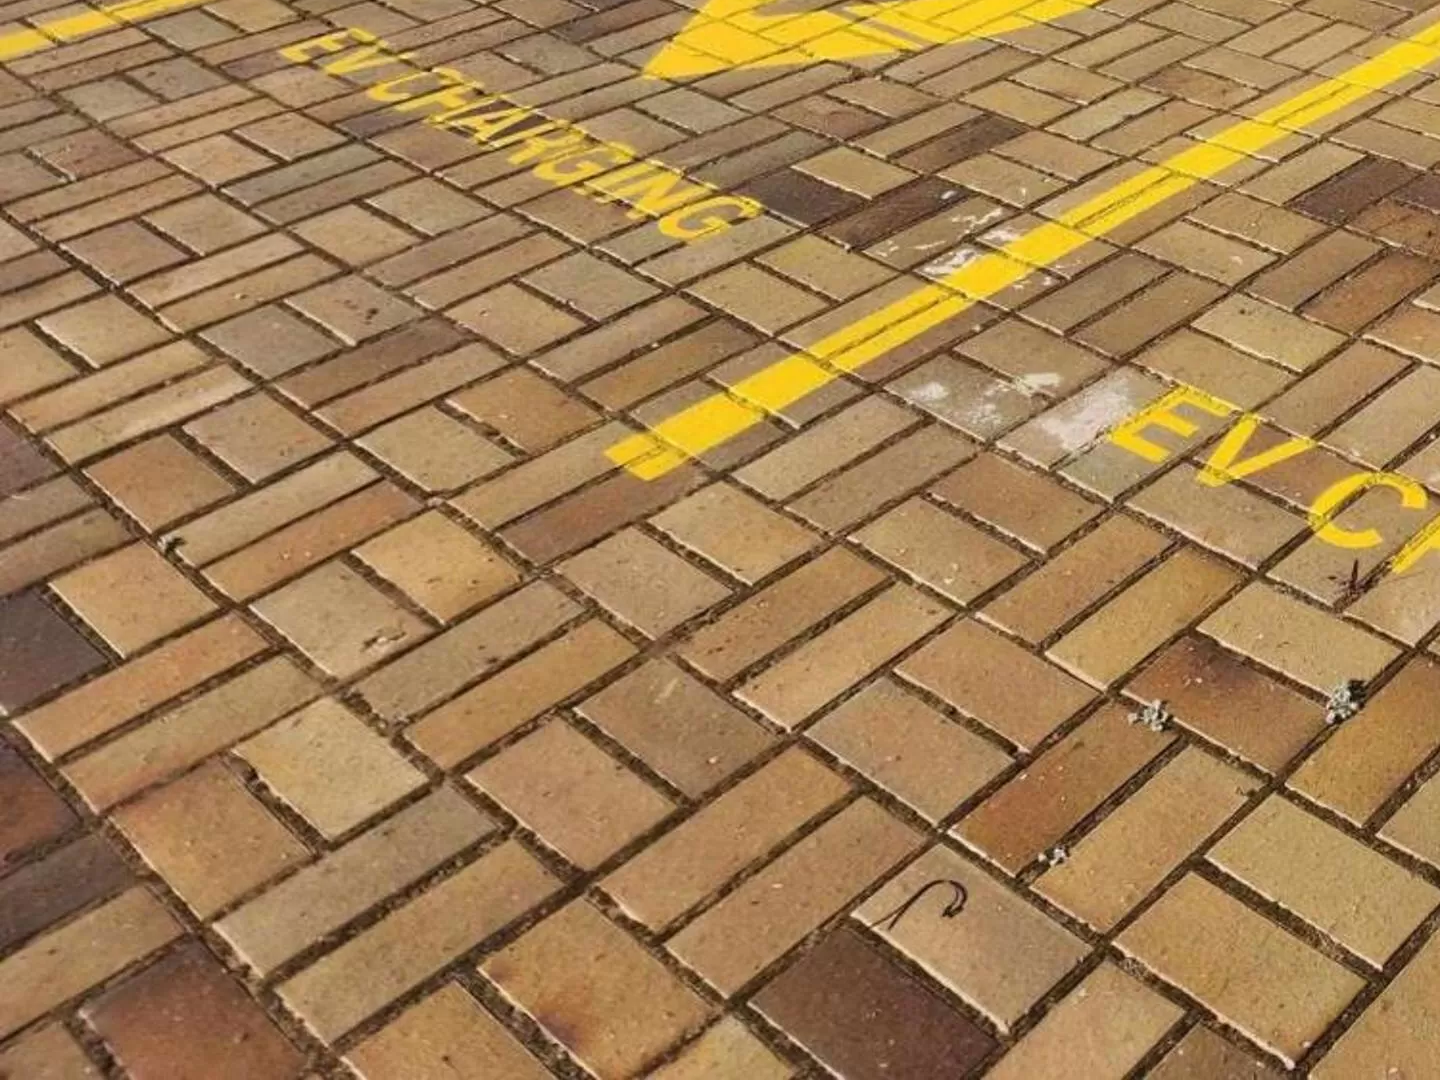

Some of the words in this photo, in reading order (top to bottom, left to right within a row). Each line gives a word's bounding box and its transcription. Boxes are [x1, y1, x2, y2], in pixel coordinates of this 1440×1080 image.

[278, 27, 422, 76] EV
[367, 67, 765, 241] CHARGING
[1109, 385, 1314, 487] EV
